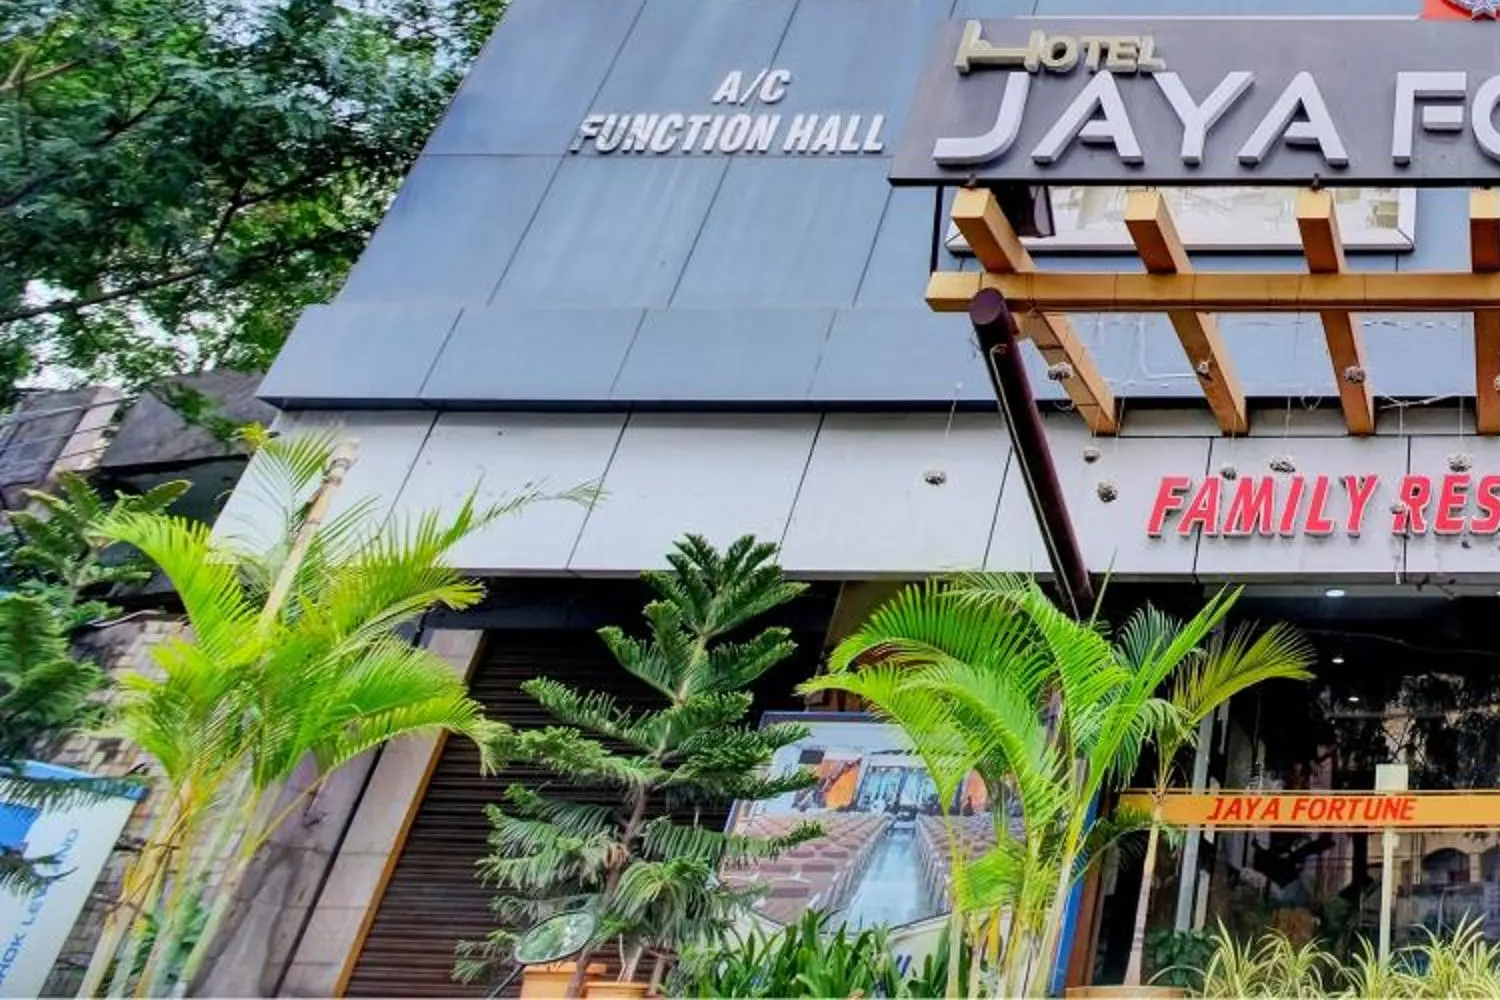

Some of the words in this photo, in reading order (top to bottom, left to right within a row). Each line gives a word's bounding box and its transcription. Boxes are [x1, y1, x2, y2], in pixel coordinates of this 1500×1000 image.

[954, 20, 1167, 74] HOTEL
[712, 69, 791, 106] A/C
[570, 114, 782, 155] FUNCTION
[783, 114, 886, 155] HALL
[933, 71, 1350, 165] JAYA
[1147, 473, 1379, 537] FAMILY
[1206, 797, 1280, 821] JAYA
[1290, 797, 1419, 821] FORTUNE
